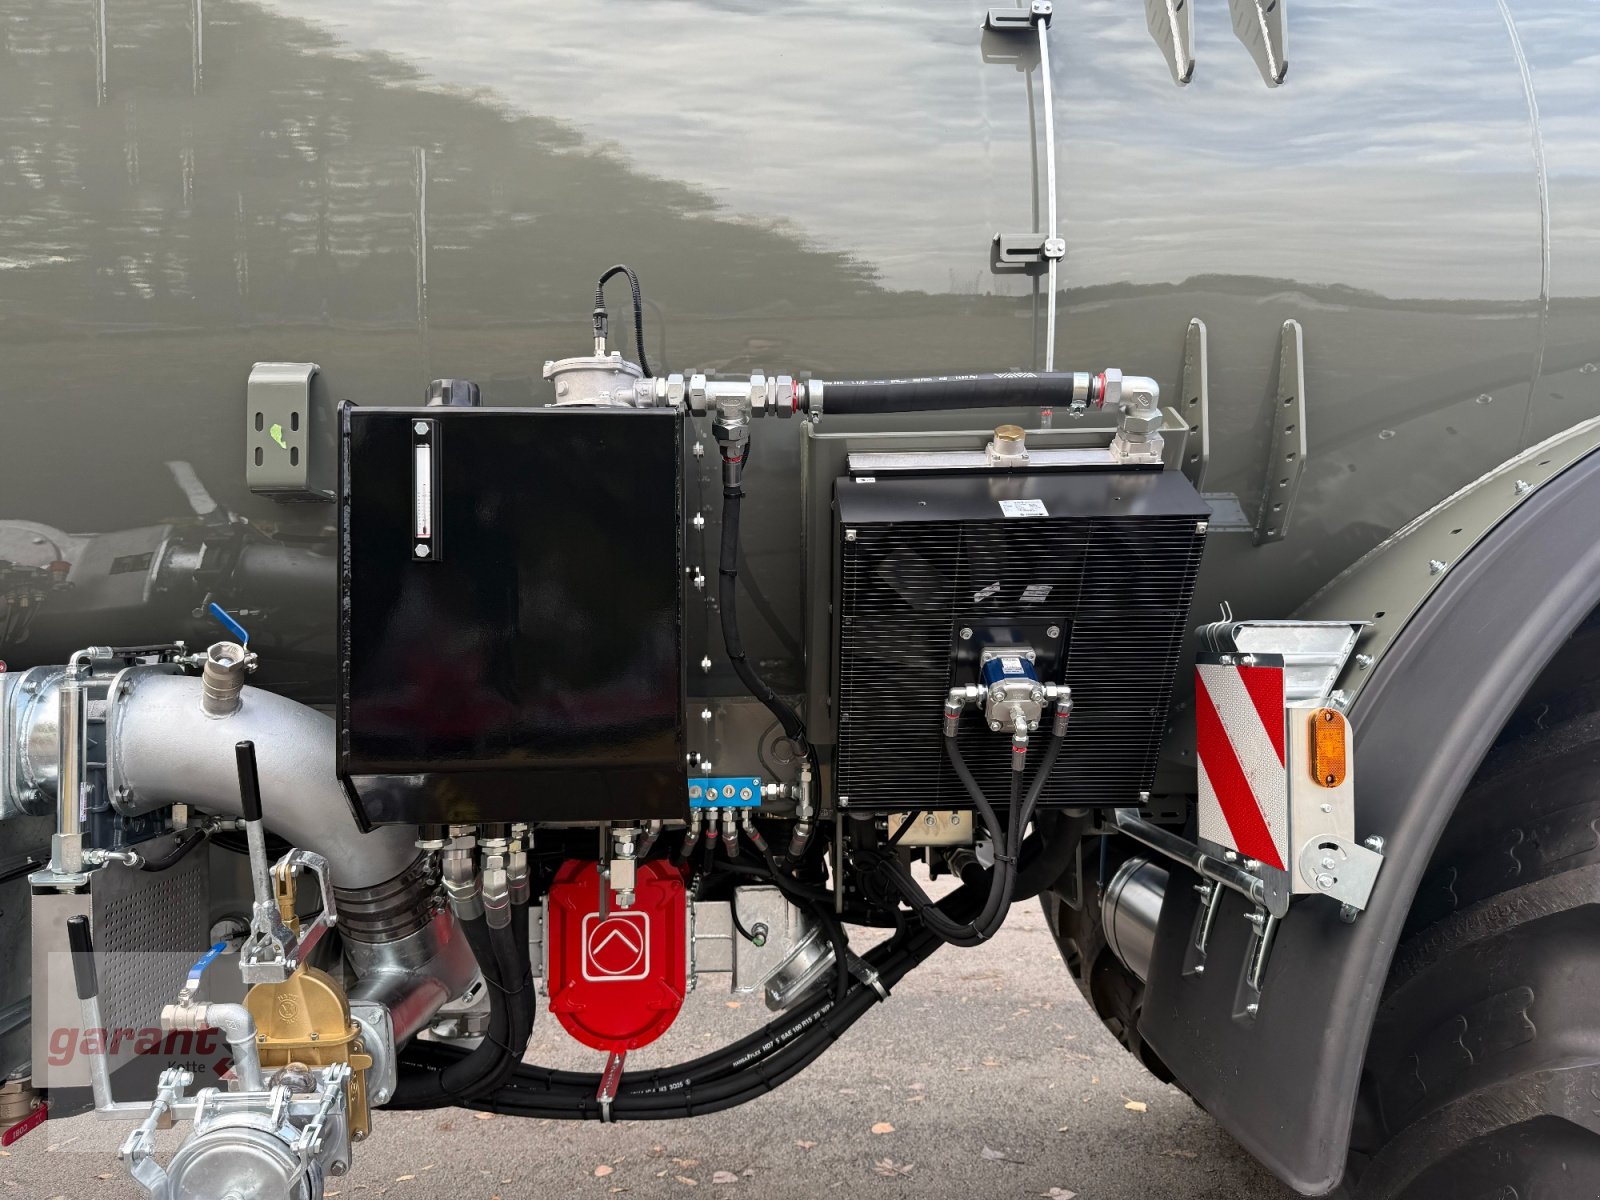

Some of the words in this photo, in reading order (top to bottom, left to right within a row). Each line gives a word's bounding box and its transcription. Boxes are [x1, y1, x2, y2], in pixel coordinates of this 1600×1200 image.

[780, 1029, 793, 1040] SAE
[792, 1023, 803, 1033] 100
[801, 1016, 813, 1027] R15
